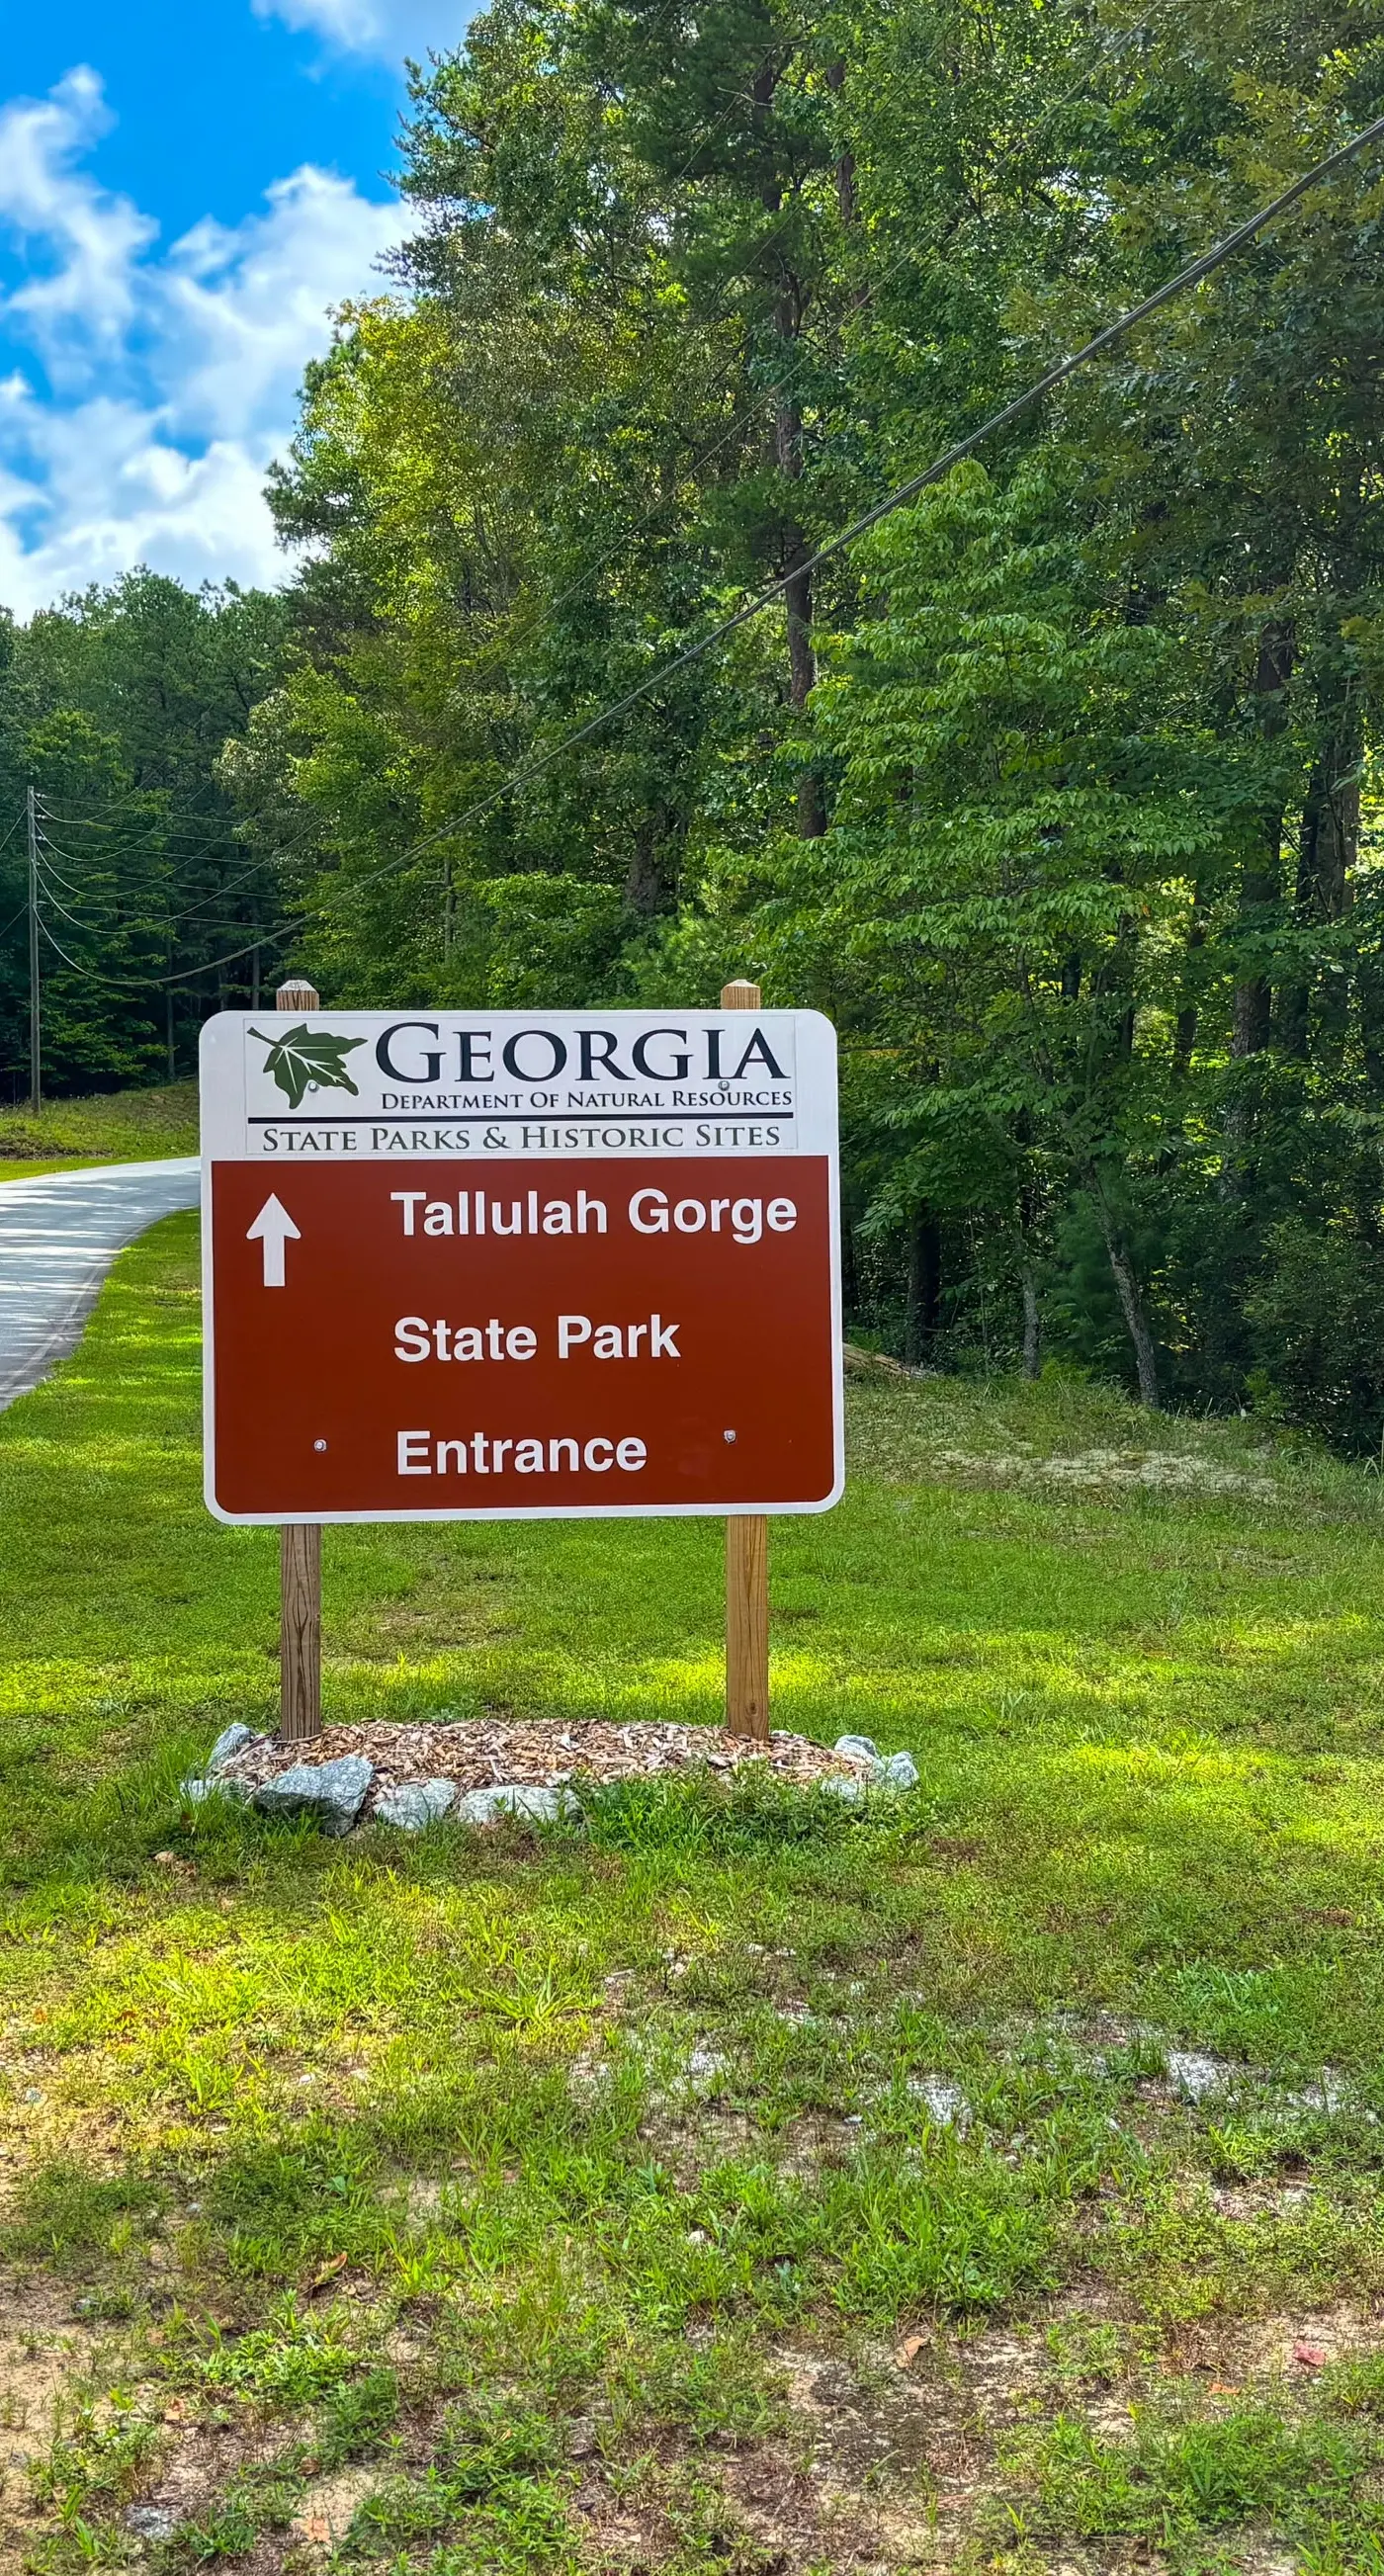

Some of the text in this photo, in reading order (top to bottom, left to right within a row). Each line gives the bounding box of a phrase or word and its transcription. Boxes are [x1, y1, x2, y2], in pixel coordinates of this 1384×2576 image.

[376, 1022, 790, 1082] GEORGIA
[383, 1089, 793, 1109] DEPARTMENT OF NATURAL RESOURCES
[264, 1124, 780, 1152] STATE PARKS & HISTORIC SITES
[390, 1188, 797, 1245] Tallulah Gorge
[394, 1314, 681, 1363] State Park
[396, 1430, 648, 1476] Entrance
